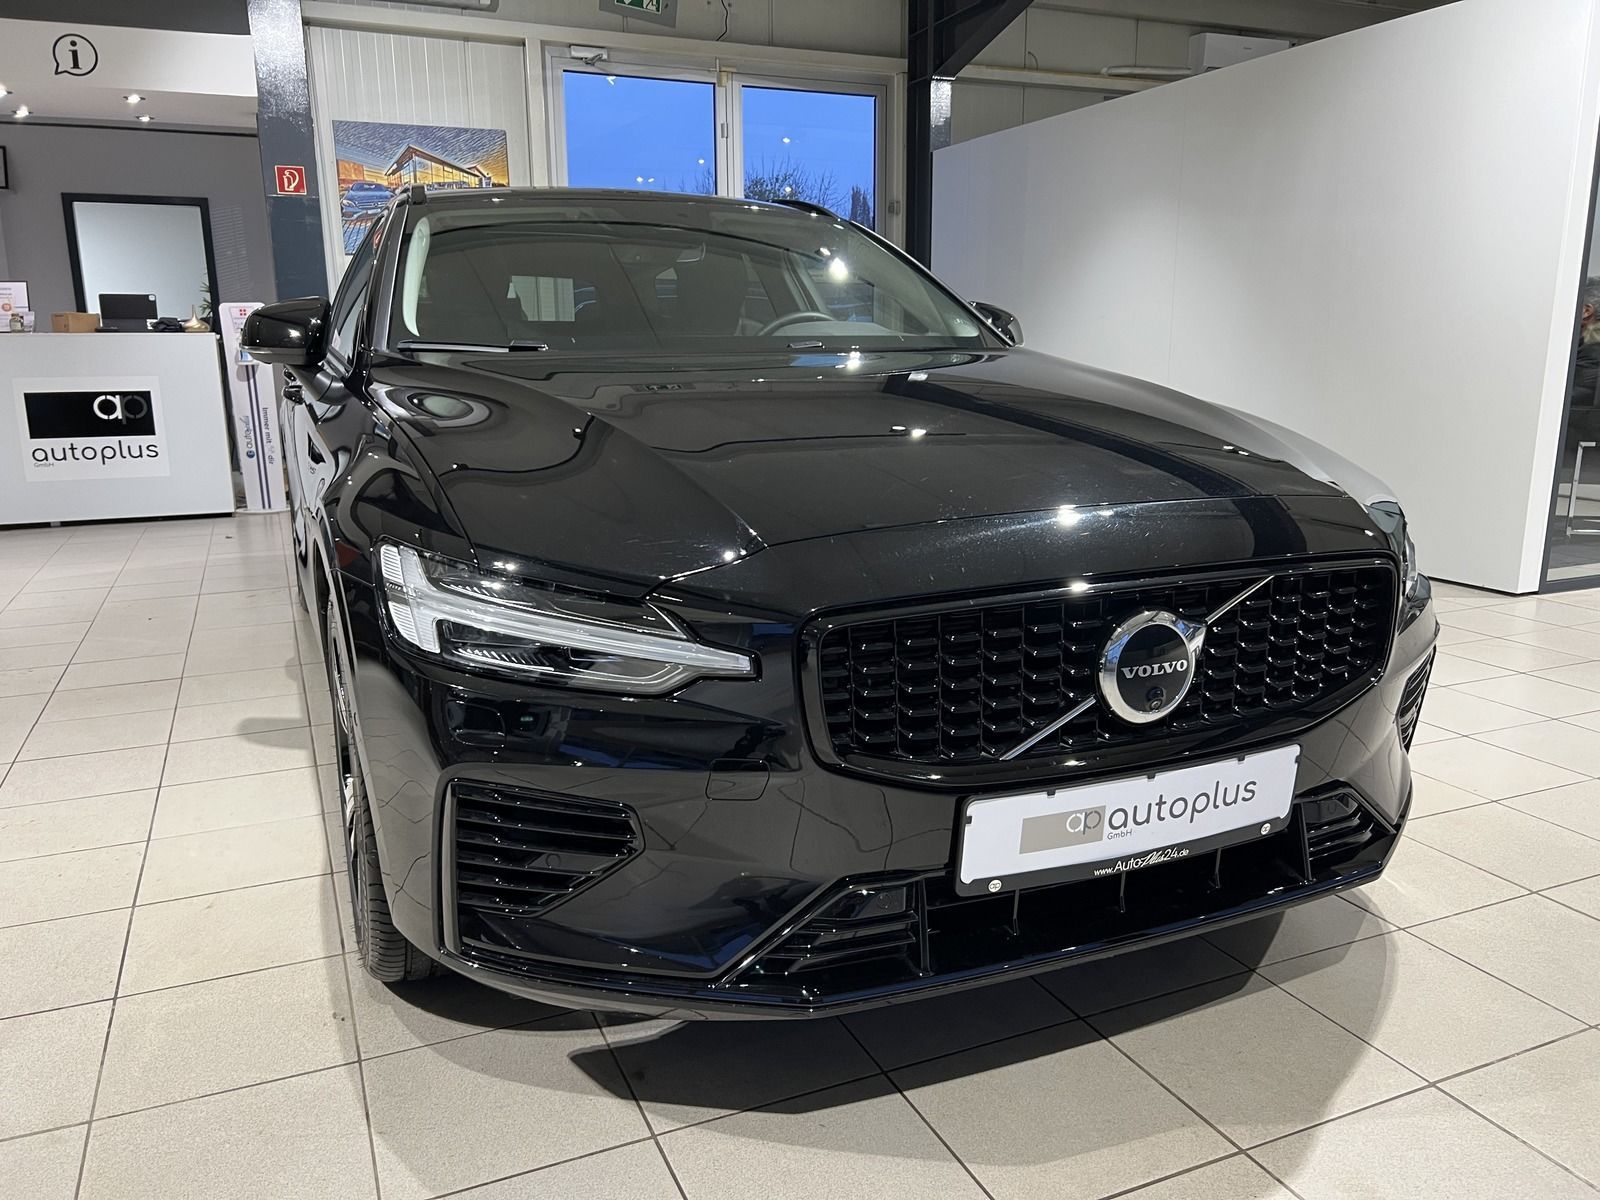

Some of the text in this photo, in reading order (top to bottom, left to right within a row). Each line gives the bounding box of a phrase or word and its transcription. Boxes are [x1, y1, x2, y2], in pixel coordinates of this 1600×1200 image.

[262, 407, 270, 430] Immer
[32, 439, 159, 465] autoplus
[1121, 659, 1188, 679] VOLVO
[1108, 780, 1257, 830] autoplus
[1107, 829, 1133, 840] GmbH
